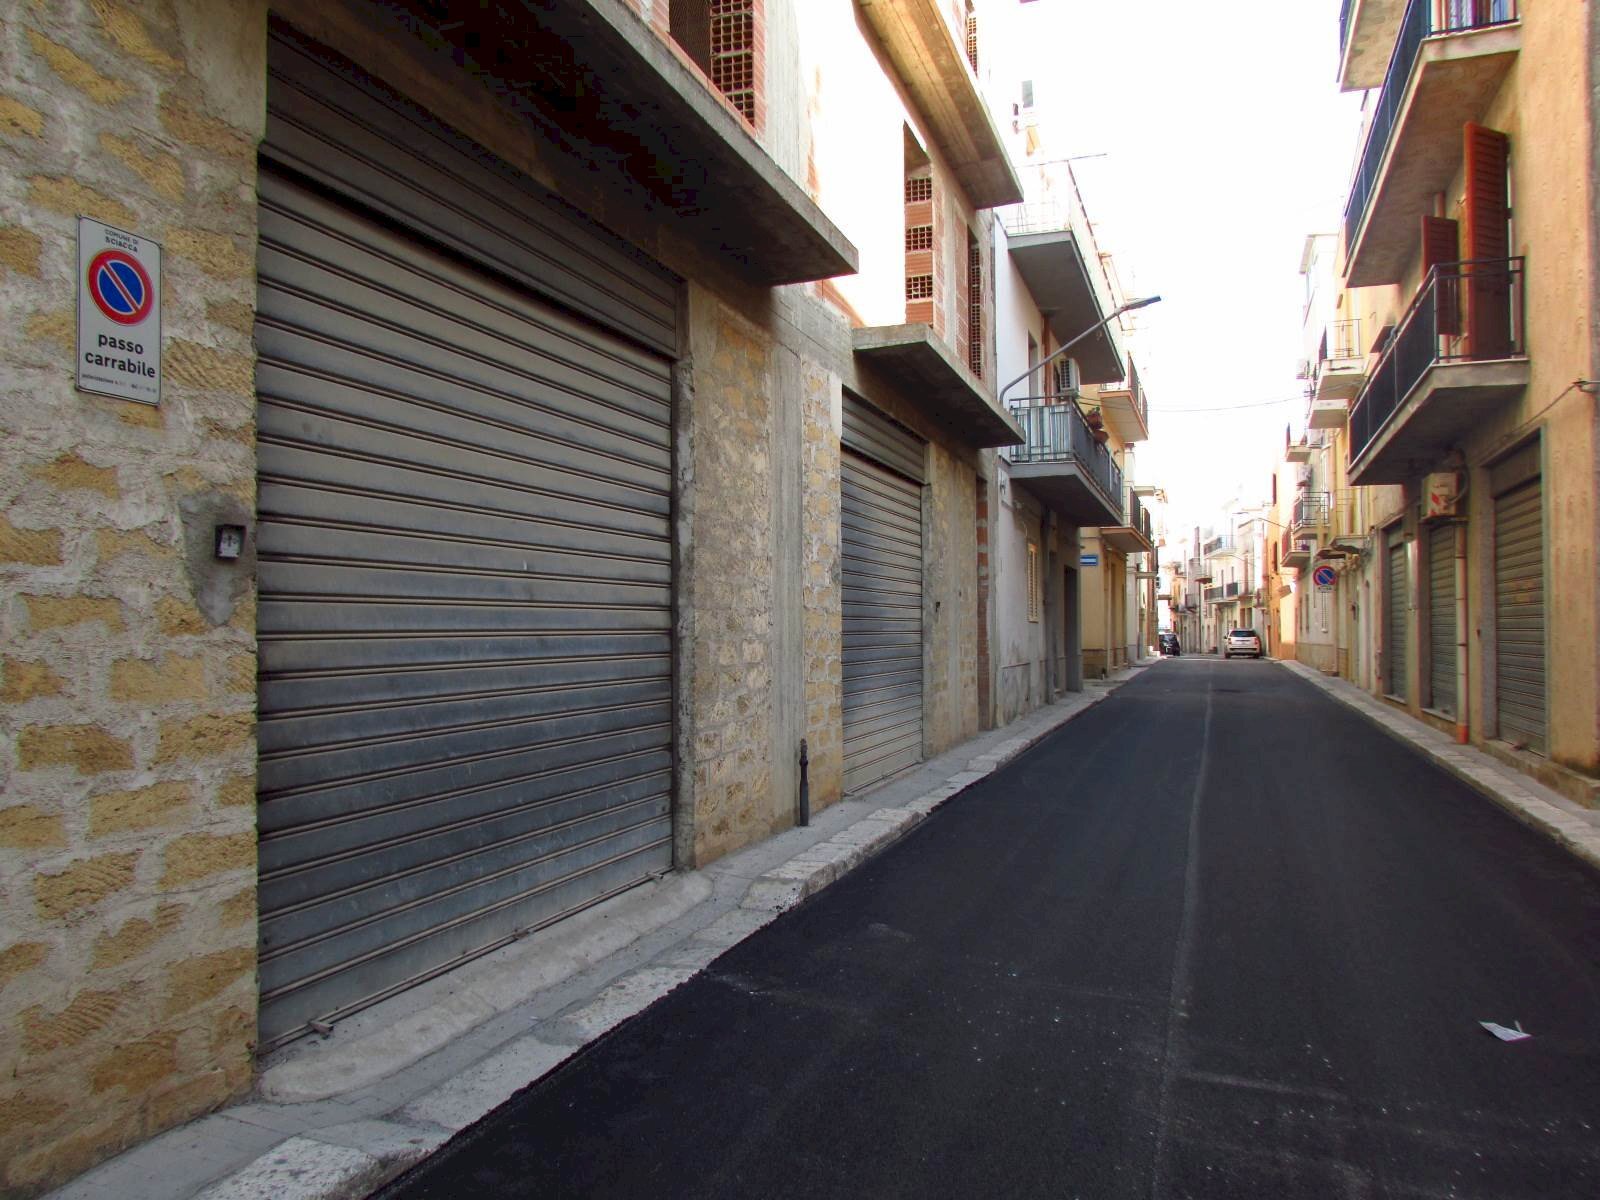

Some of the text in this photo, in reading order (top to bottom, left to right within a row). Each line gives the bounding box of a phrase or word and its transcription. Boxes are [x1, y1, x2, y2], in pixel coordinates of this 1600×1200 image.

[105, 236, 138, 252] SCIACCA
[98, 334, 144, 354] passo
[85, 352, 156, 378] carrabile
